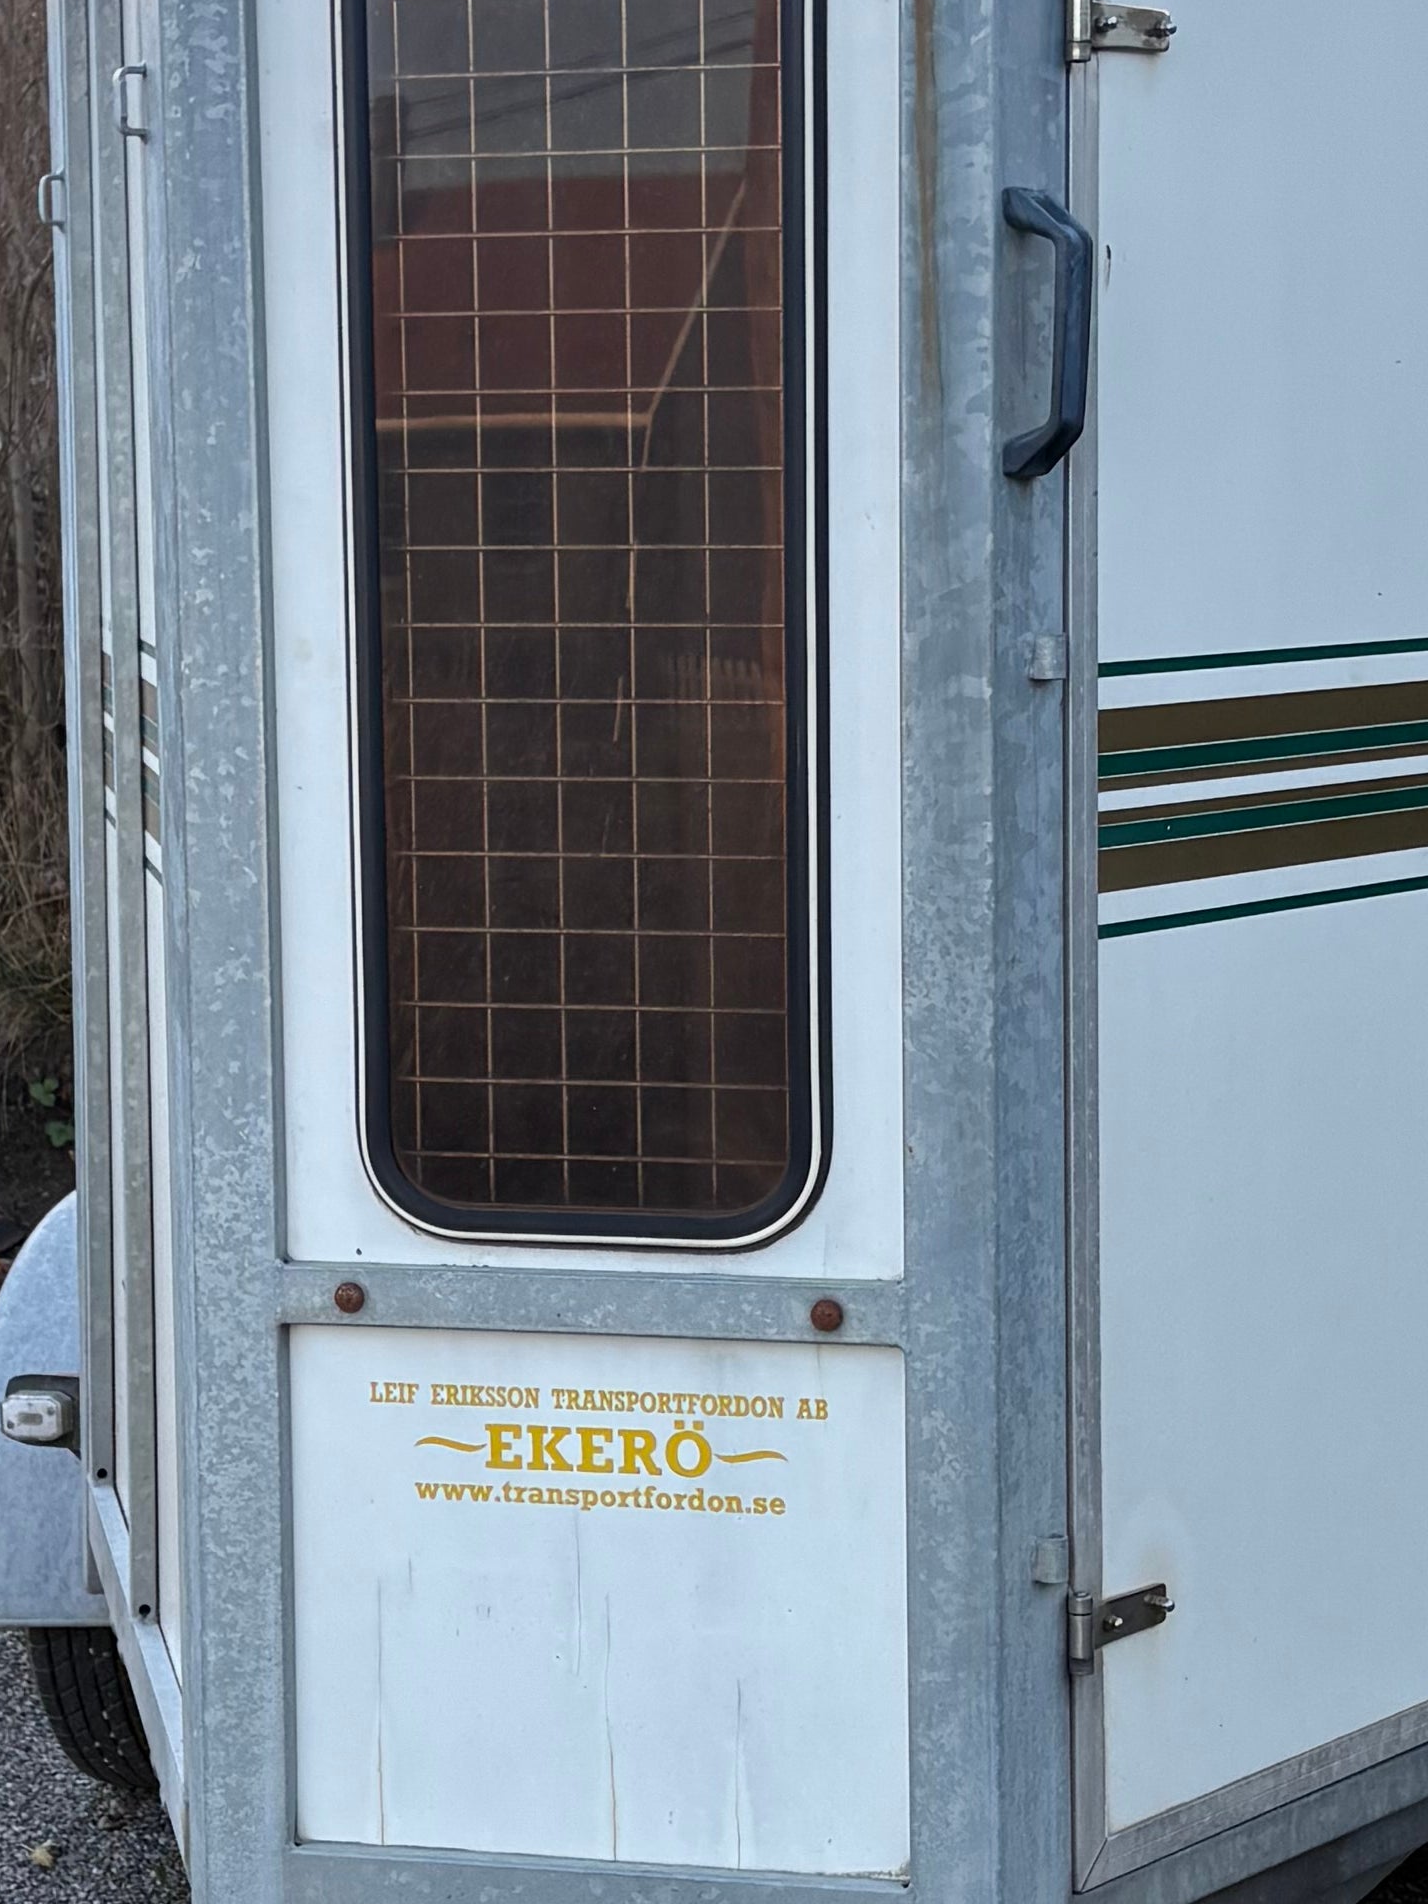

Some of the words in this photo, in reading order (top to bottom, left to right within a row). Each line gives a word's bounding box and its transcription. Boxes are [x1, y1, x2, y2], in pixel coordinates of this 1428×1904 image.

[369, 1381, 419, 1404] LEIF
[430, 1383, 540, 1408] ERIKSSON
[551, 1388, 785, 1419] TRANSPORTFORDON
[796, 1398, 829, 1421] AB
[484, 1419, 713, 1478] EKERÖ
[414, 1481, 786, 1515] www.transportfordon.se
